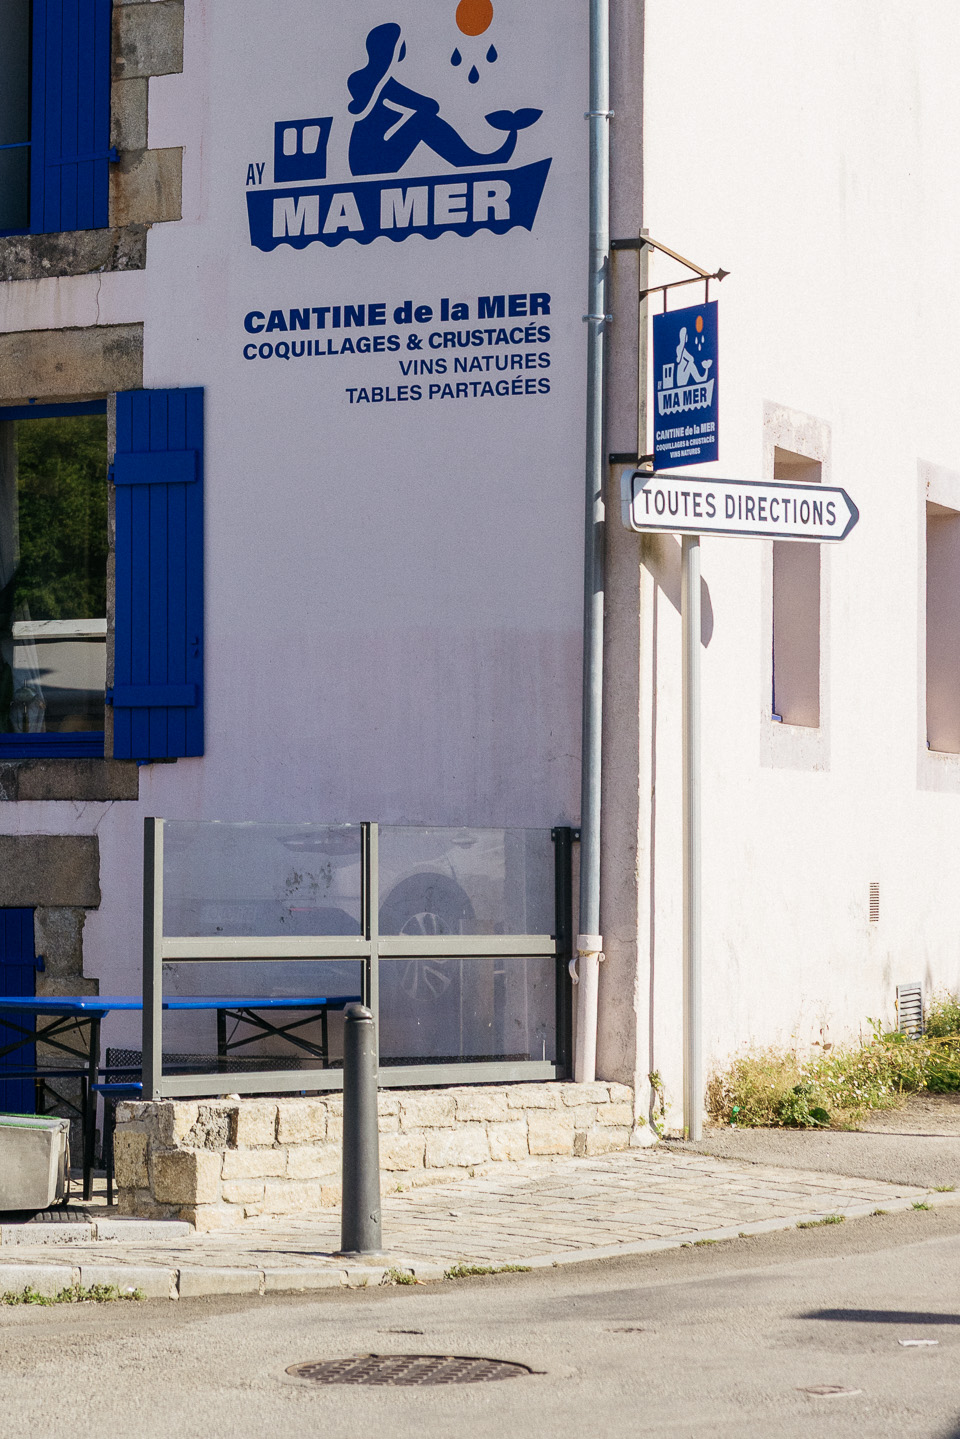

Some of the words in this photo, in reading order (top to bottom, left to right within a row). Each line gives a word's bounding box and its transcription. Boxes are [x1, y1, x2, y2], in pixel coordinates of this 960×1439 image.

[246, 163, 265, 185] AY
[272, 192, 364, 238] MA
[380, 179, 511, 229] MER
[244, 303, 386, 334] CANTINE
[393, 300, 433, 325] de
[440, 298, 469, 321] la
[478, 292, 551, 319] MER
[243, 335, 401, 360] COQUILLAGES
[406, 334, 423, 350] &
[428, 322, 551, 349] CRUSTACÉS
[399, 358, 447, 375] VINS
[454, 352, 551, 373] NATURES
[345, 384, 422, 404] TABLES
[429, 375, 551, 399] PARTAGÉES
[662, 392, 681, 410] MA
[683, 387, 707, 407] MER
[656, 426, 684, 440] CANTINE
[685, 425, 693, 436] de
[693, 424, 700, 435] la
[700, 421, 715, 433] MER
[669, 449, 680, 458] VINS
[642, 489, 716, 518] TOUTES
[725, 494, 836, 526] DIRECTIONS
